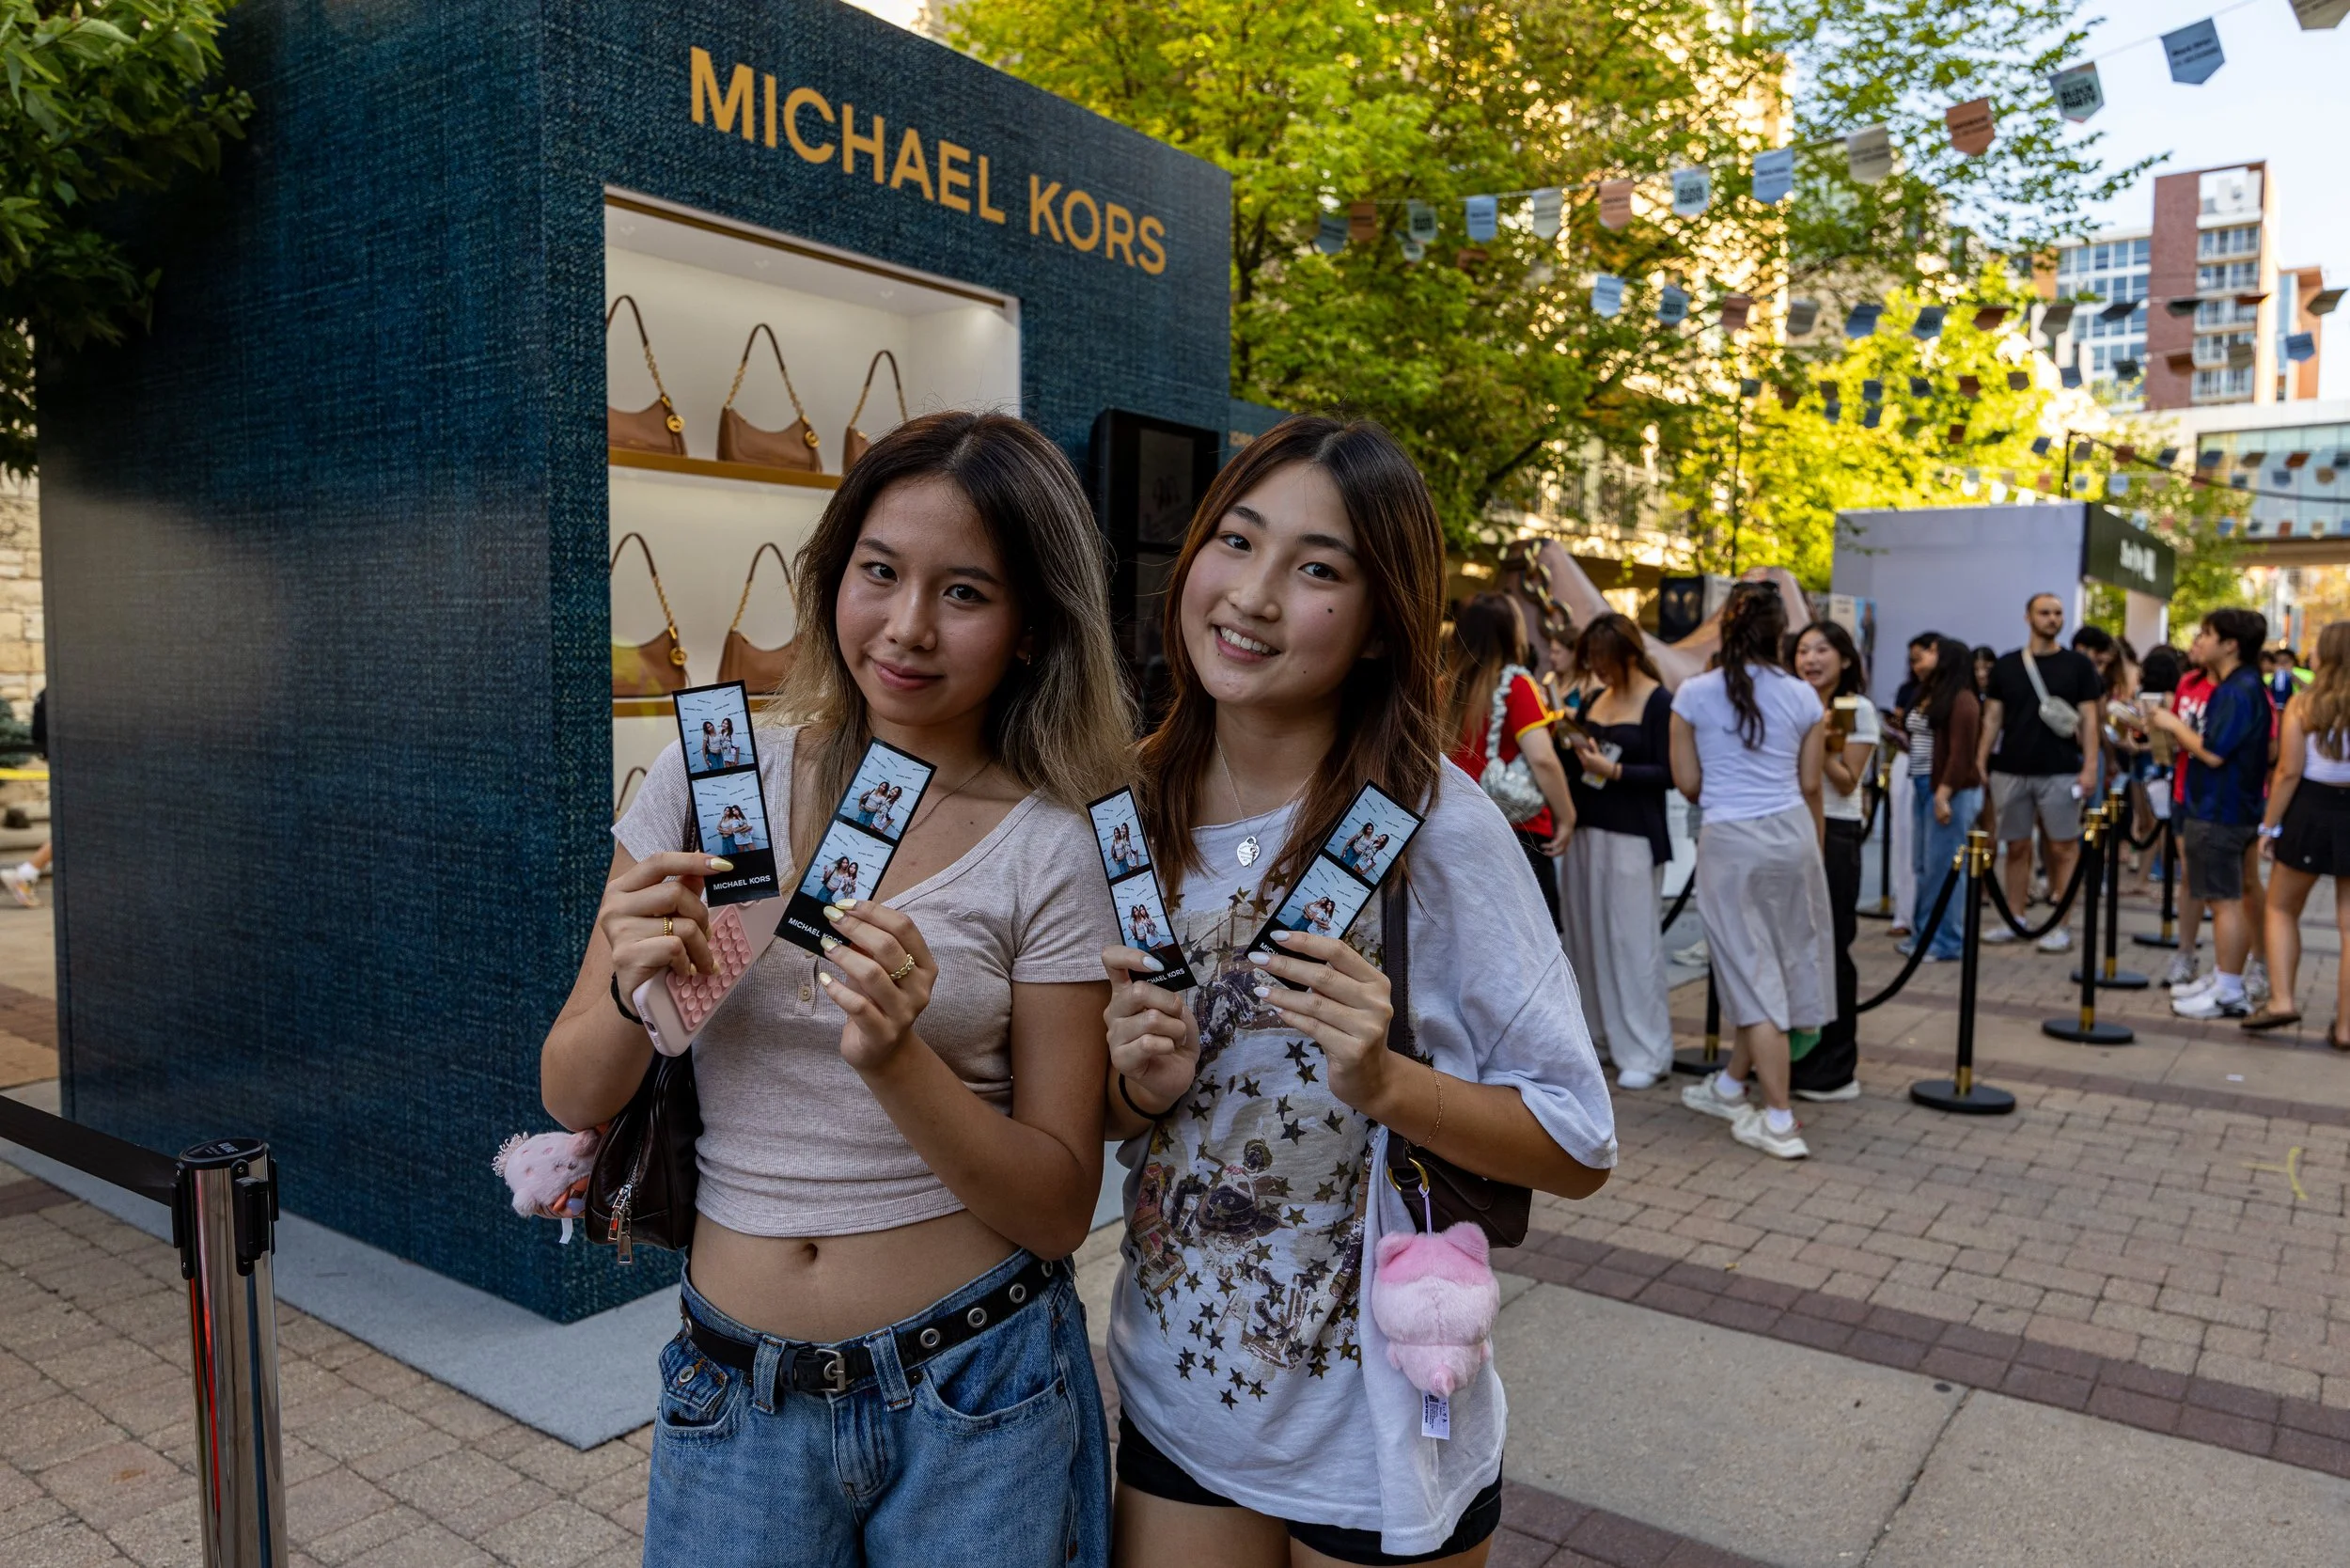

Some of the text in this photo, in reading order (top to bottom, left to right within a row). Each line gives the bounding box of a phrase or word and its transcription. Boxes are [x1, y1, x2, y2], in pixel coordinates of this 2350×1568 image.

[691, 46, 1167, 274] MICHAEL KORS
[713, 875, 771, 891] MICHAEL KORS
[788, 917, 821, 937] MICHAEL
[1167, 968, 1185, 979] KORS
